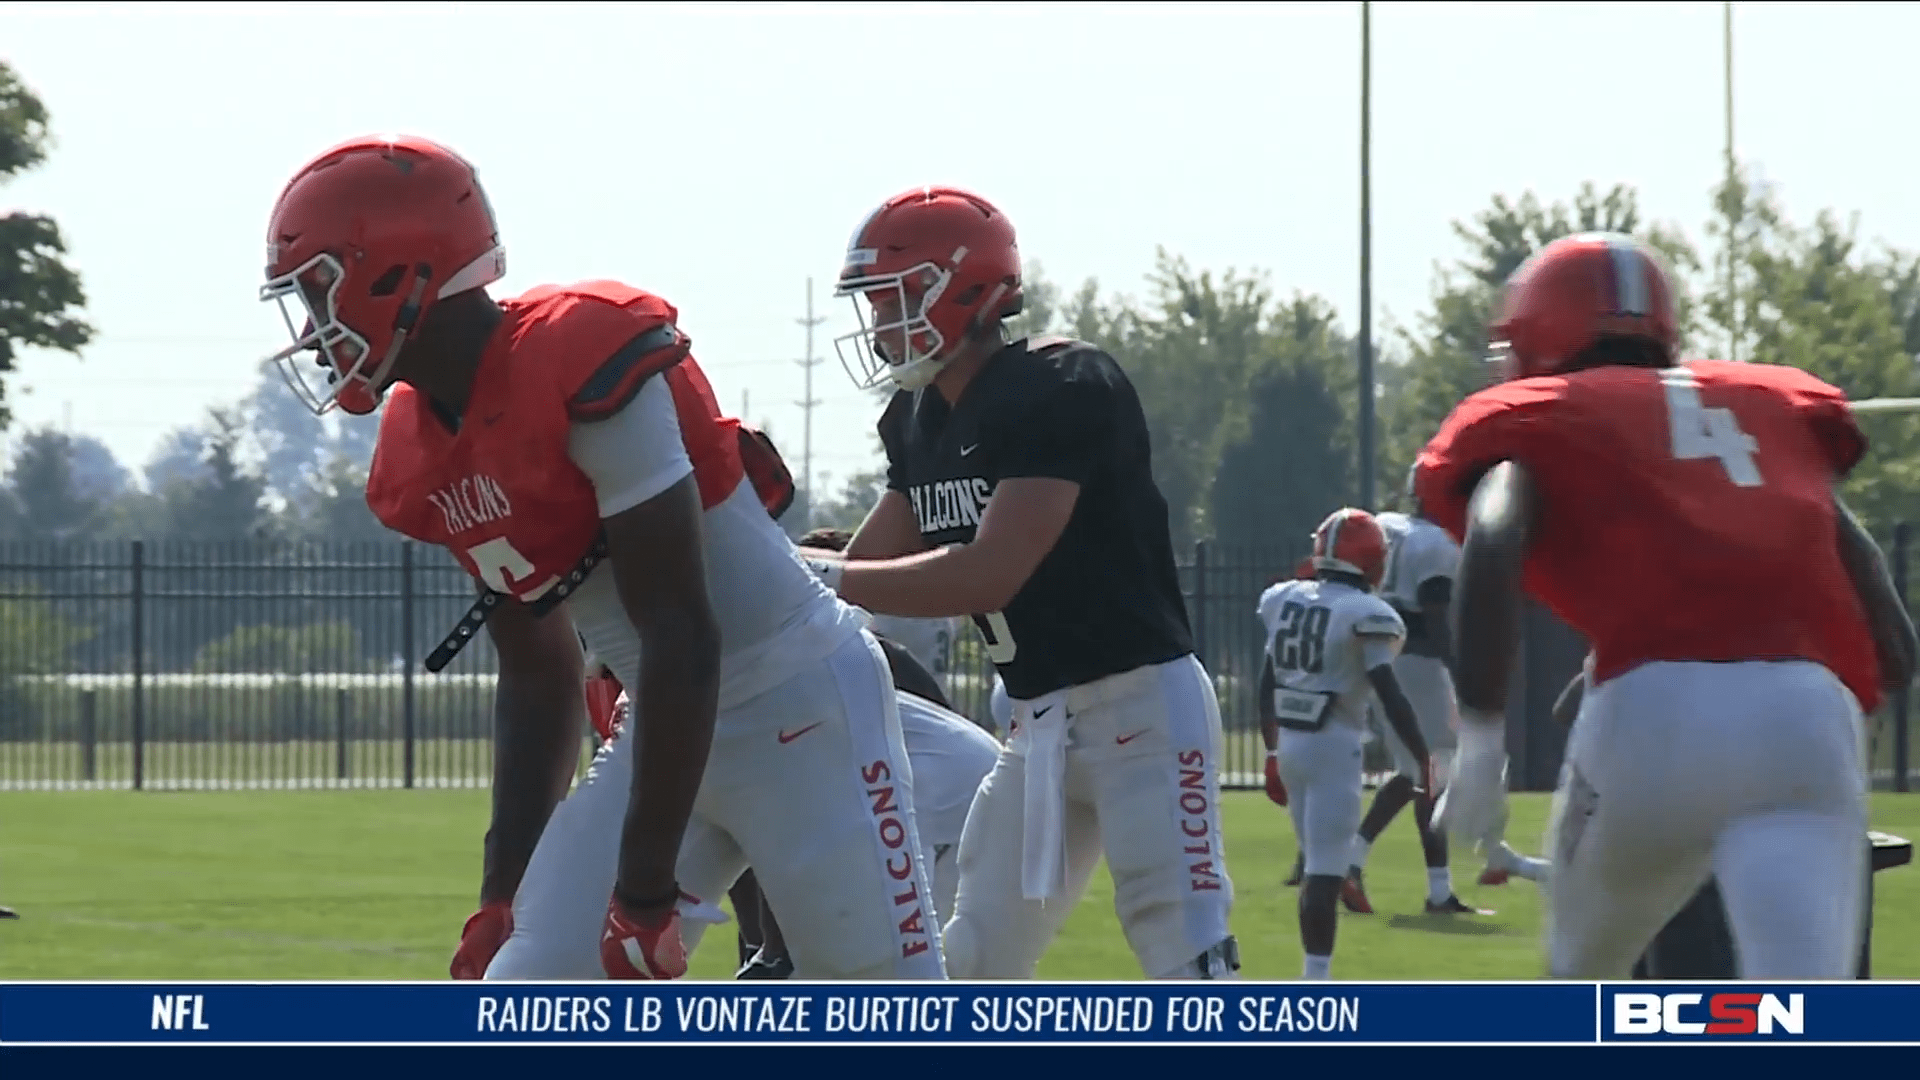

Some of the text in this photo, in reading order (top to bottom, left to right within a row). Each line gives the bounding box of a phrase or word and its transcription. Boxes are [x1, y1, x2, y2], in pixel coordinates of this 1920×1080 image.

[1659, 367, 1764, 488] 4
[908, 477, 994, 534] ALCONS
[1275, 600, 1332, 674] 28
[860, 759, 929, 959] FALCONS
[1177, 748, 1222, 892] FALCONS
